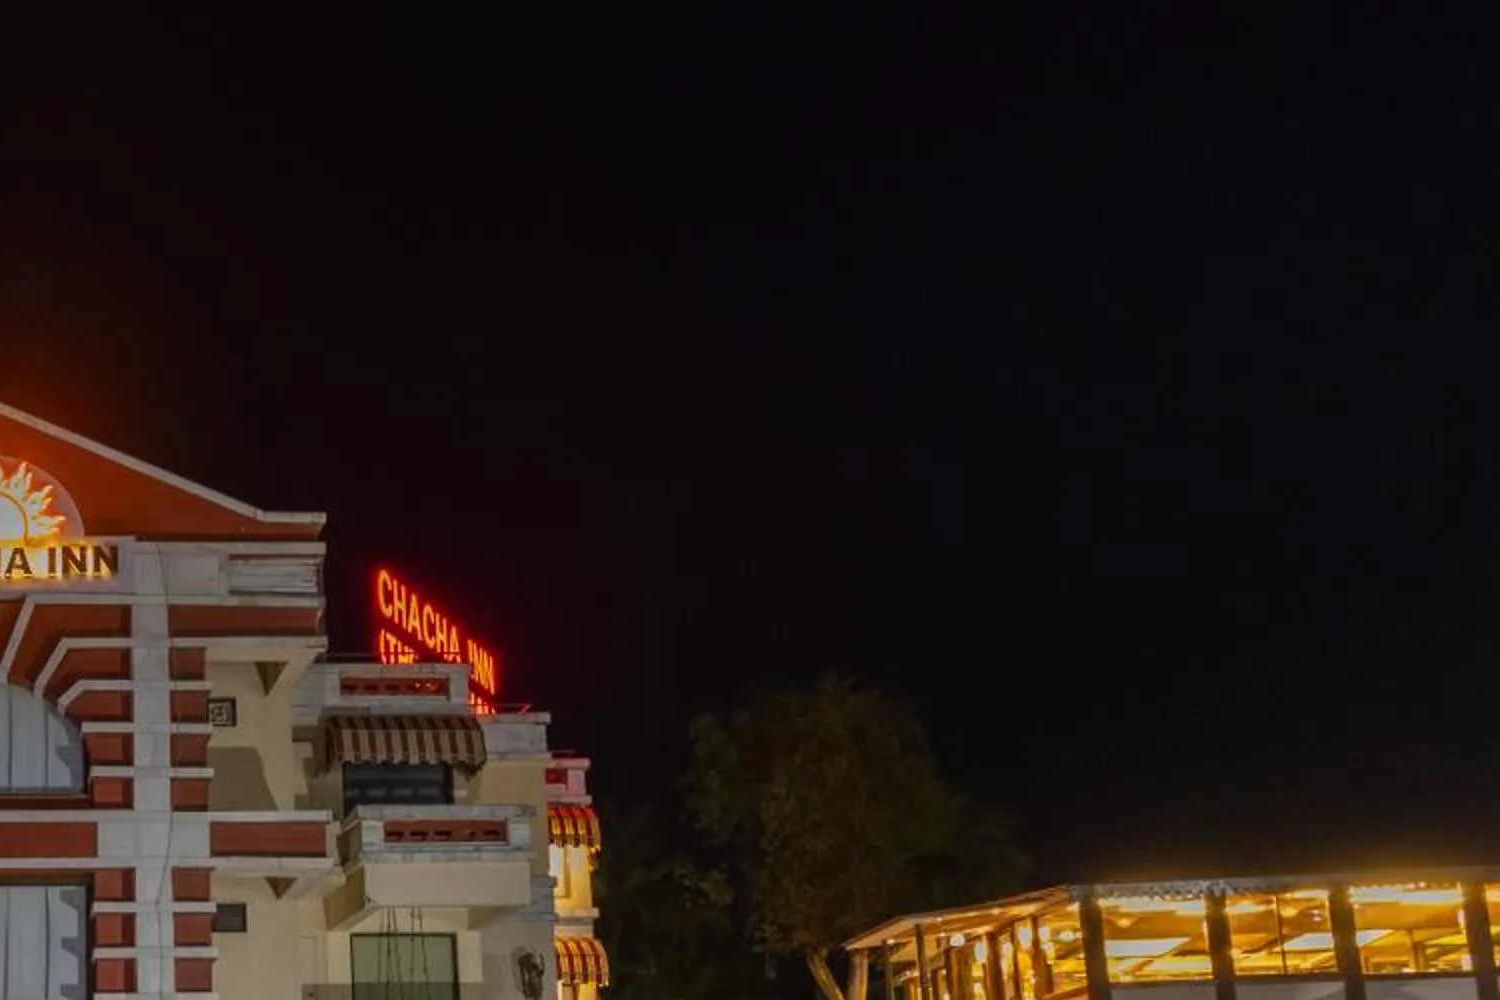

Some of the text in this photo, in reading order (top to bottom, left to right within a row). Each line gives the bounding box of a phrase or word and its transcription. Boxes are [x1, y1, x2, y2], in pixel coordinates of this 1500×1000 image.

[48, 545, 119, 576] INN
[377, 568, 495, 696] CHACHA INN
